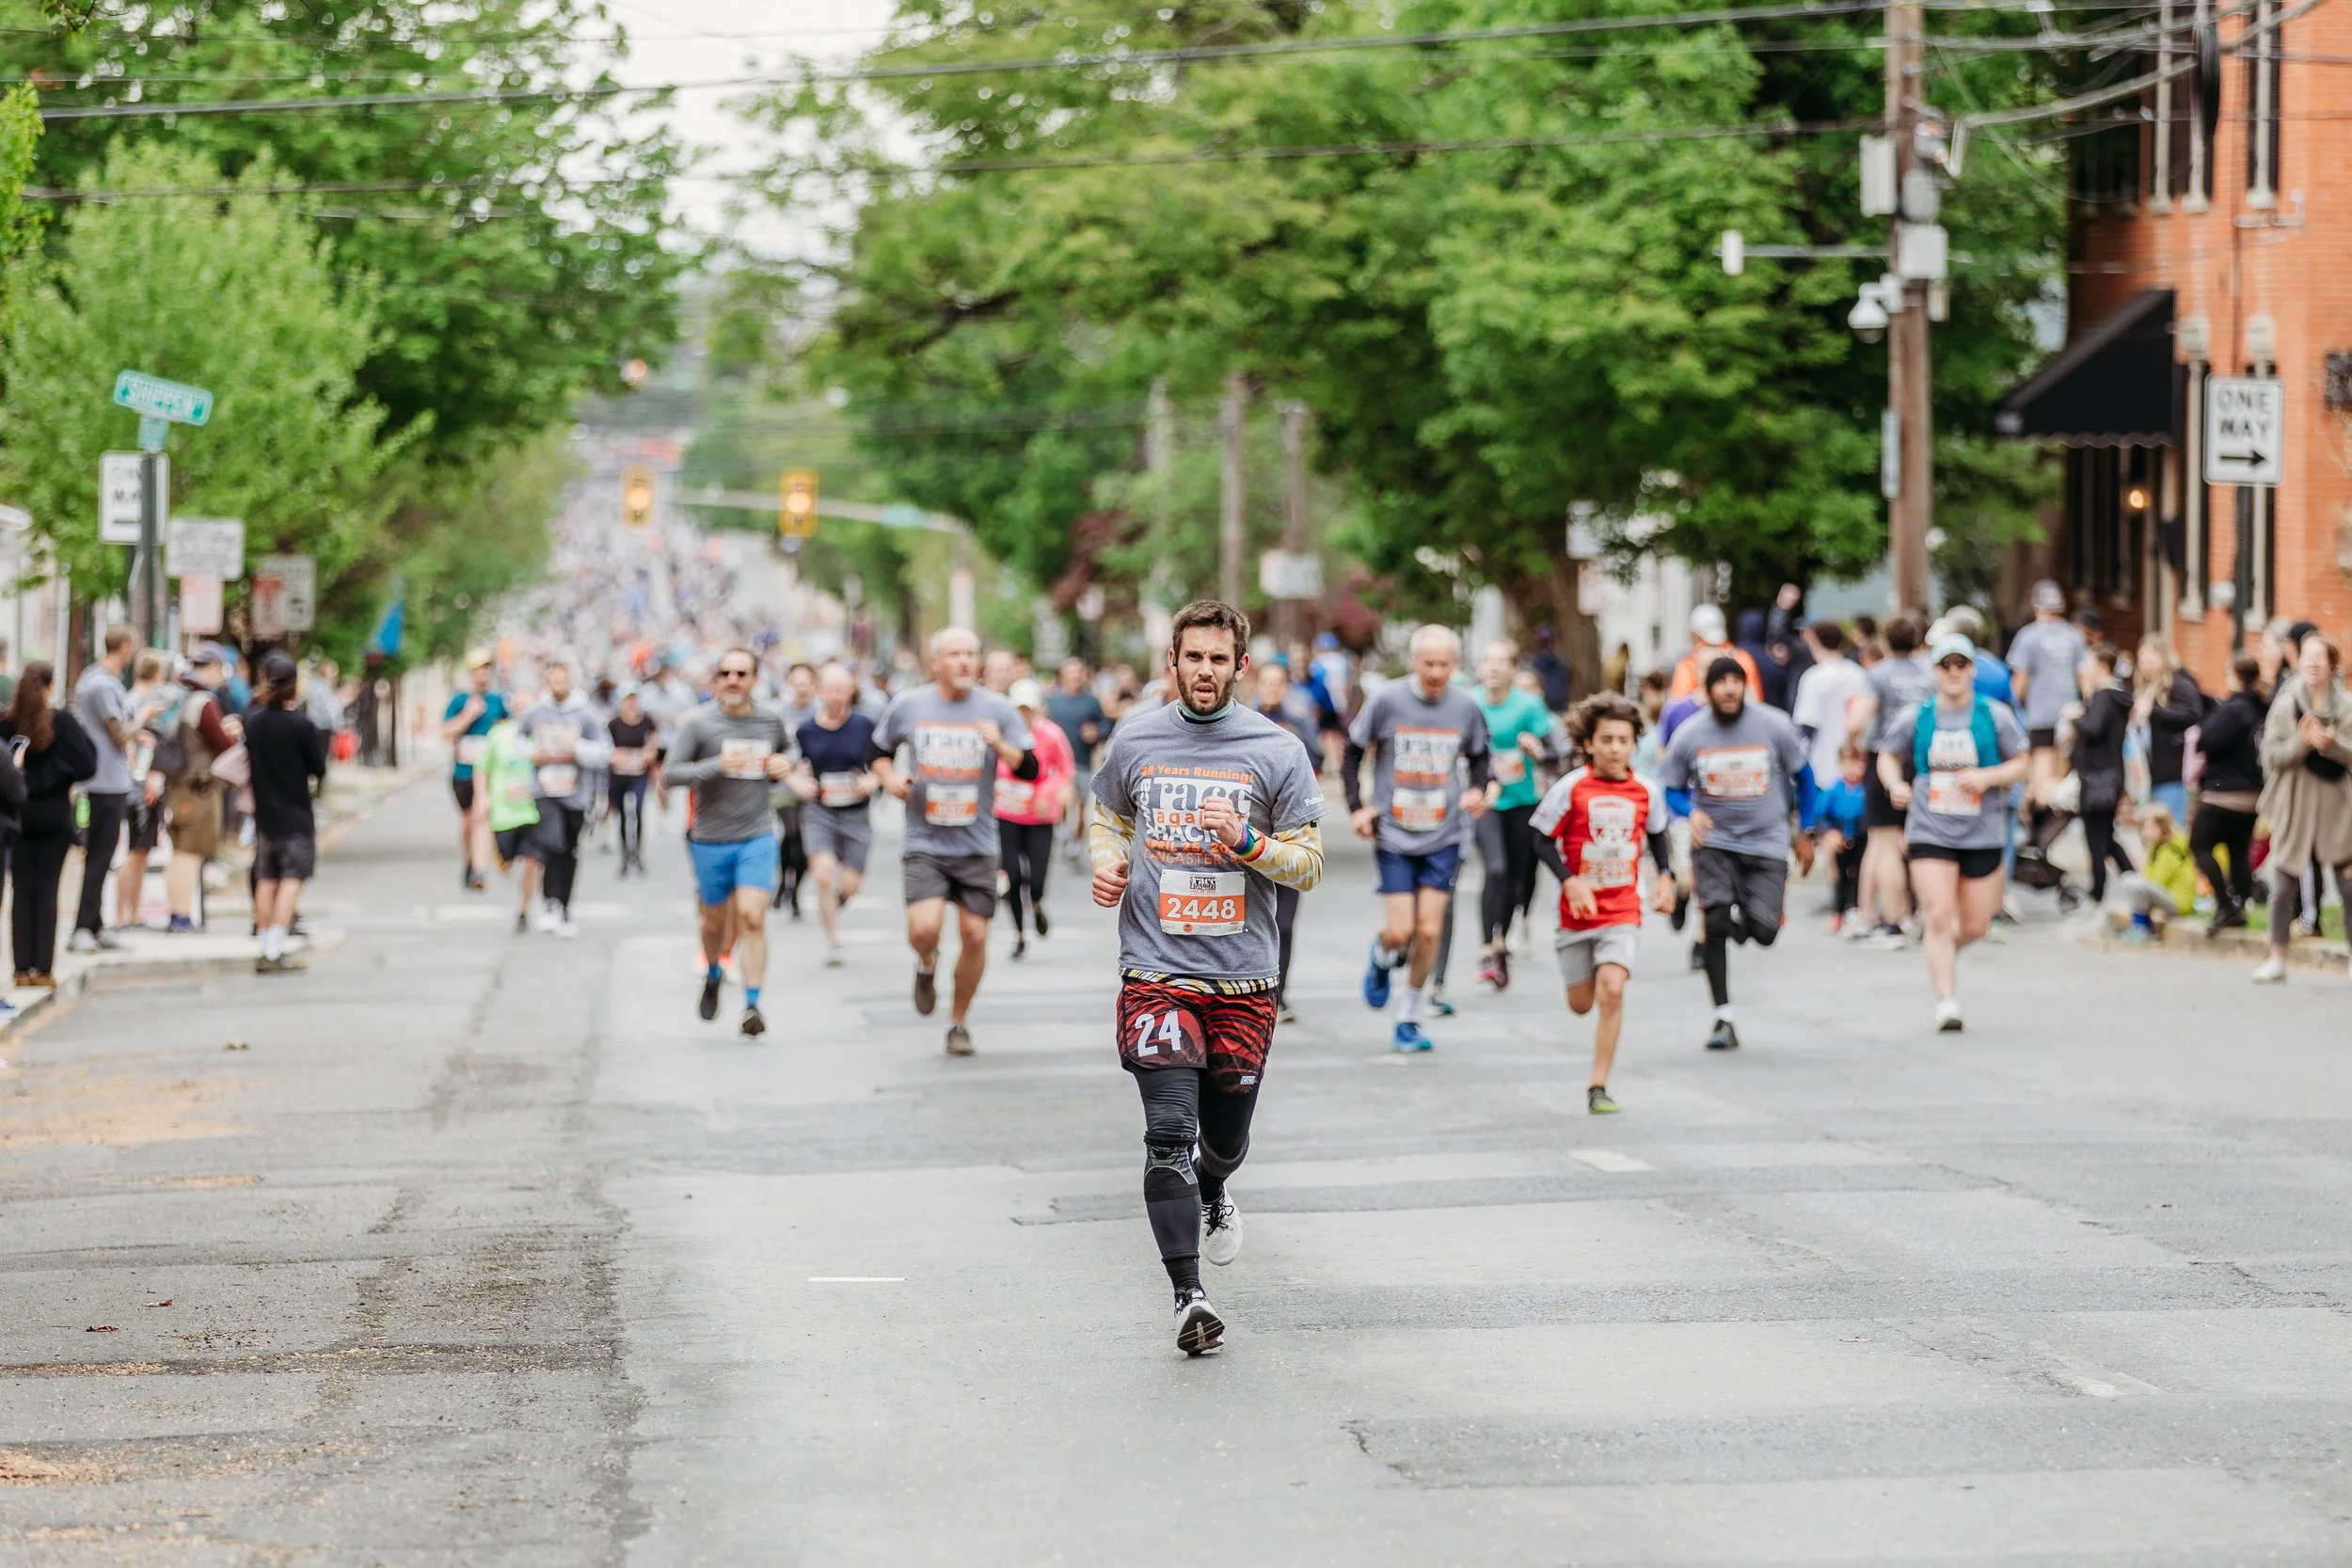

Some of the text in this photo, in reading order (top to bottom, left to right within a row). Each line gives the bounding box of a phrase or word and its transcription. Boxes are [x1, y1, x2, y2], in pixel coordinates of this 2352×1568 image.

[2217, 390, 2272, 413] ONE
[2219, 419, 2273, 438] WAY
[1157, 764, 1190, 776] Years
[1193, 767, 1255, 783] Running!
[1156, 810, 1245, 828] agait
[1145, 838, 1178, 852] APRIL
[1211, 842, 1235, 854] 20
[1144, 847, 1226, 865] LANCASTER,
[1166, 896, 1236, 920] 2448
[1134, 1009, 1182, 1057] 24
